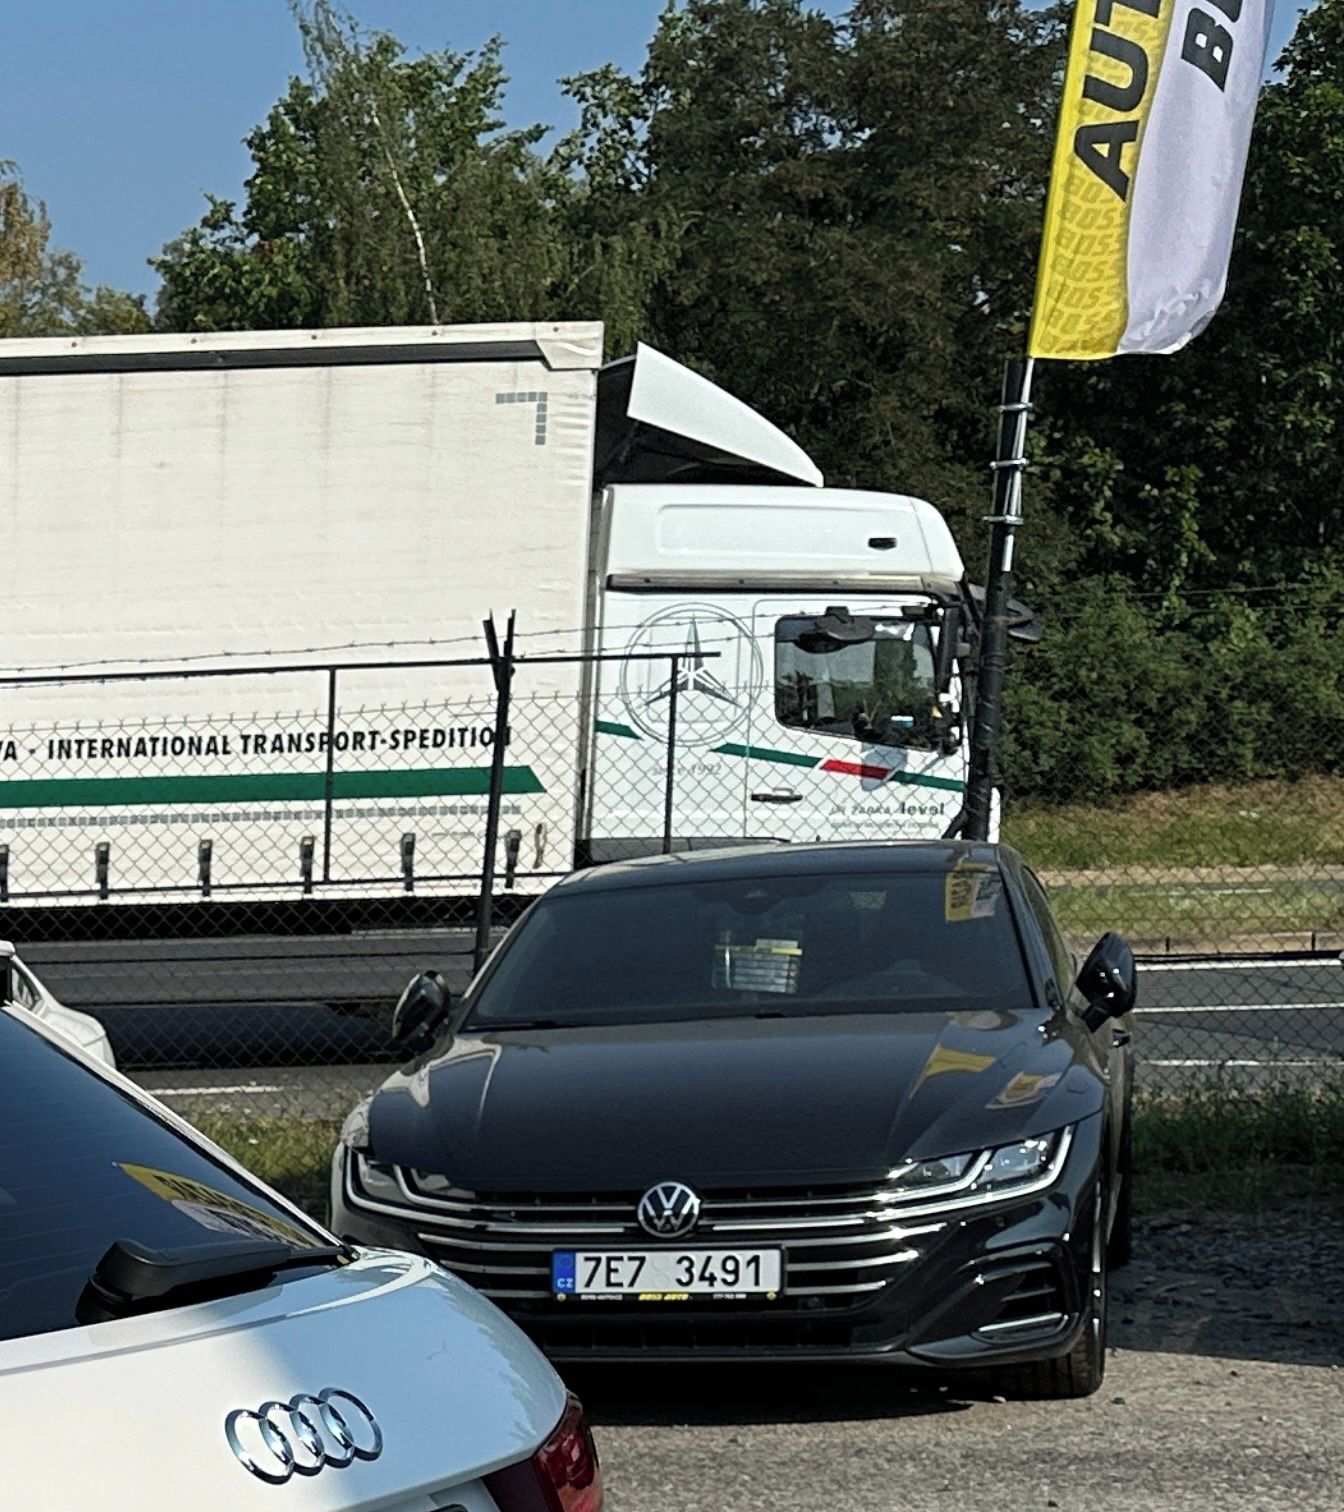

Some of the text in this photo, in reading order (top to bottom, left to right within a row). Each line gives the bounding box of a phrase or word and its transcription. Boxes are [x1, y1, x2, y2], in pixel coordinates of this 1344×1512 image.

[1181, 0, 1243, 93] B
[48, 735, 232, 760] INTERNATIONAL
[557, 1278, 574, 1289] CZ
[583, 1254, 761, 1288] 7E7 3491
